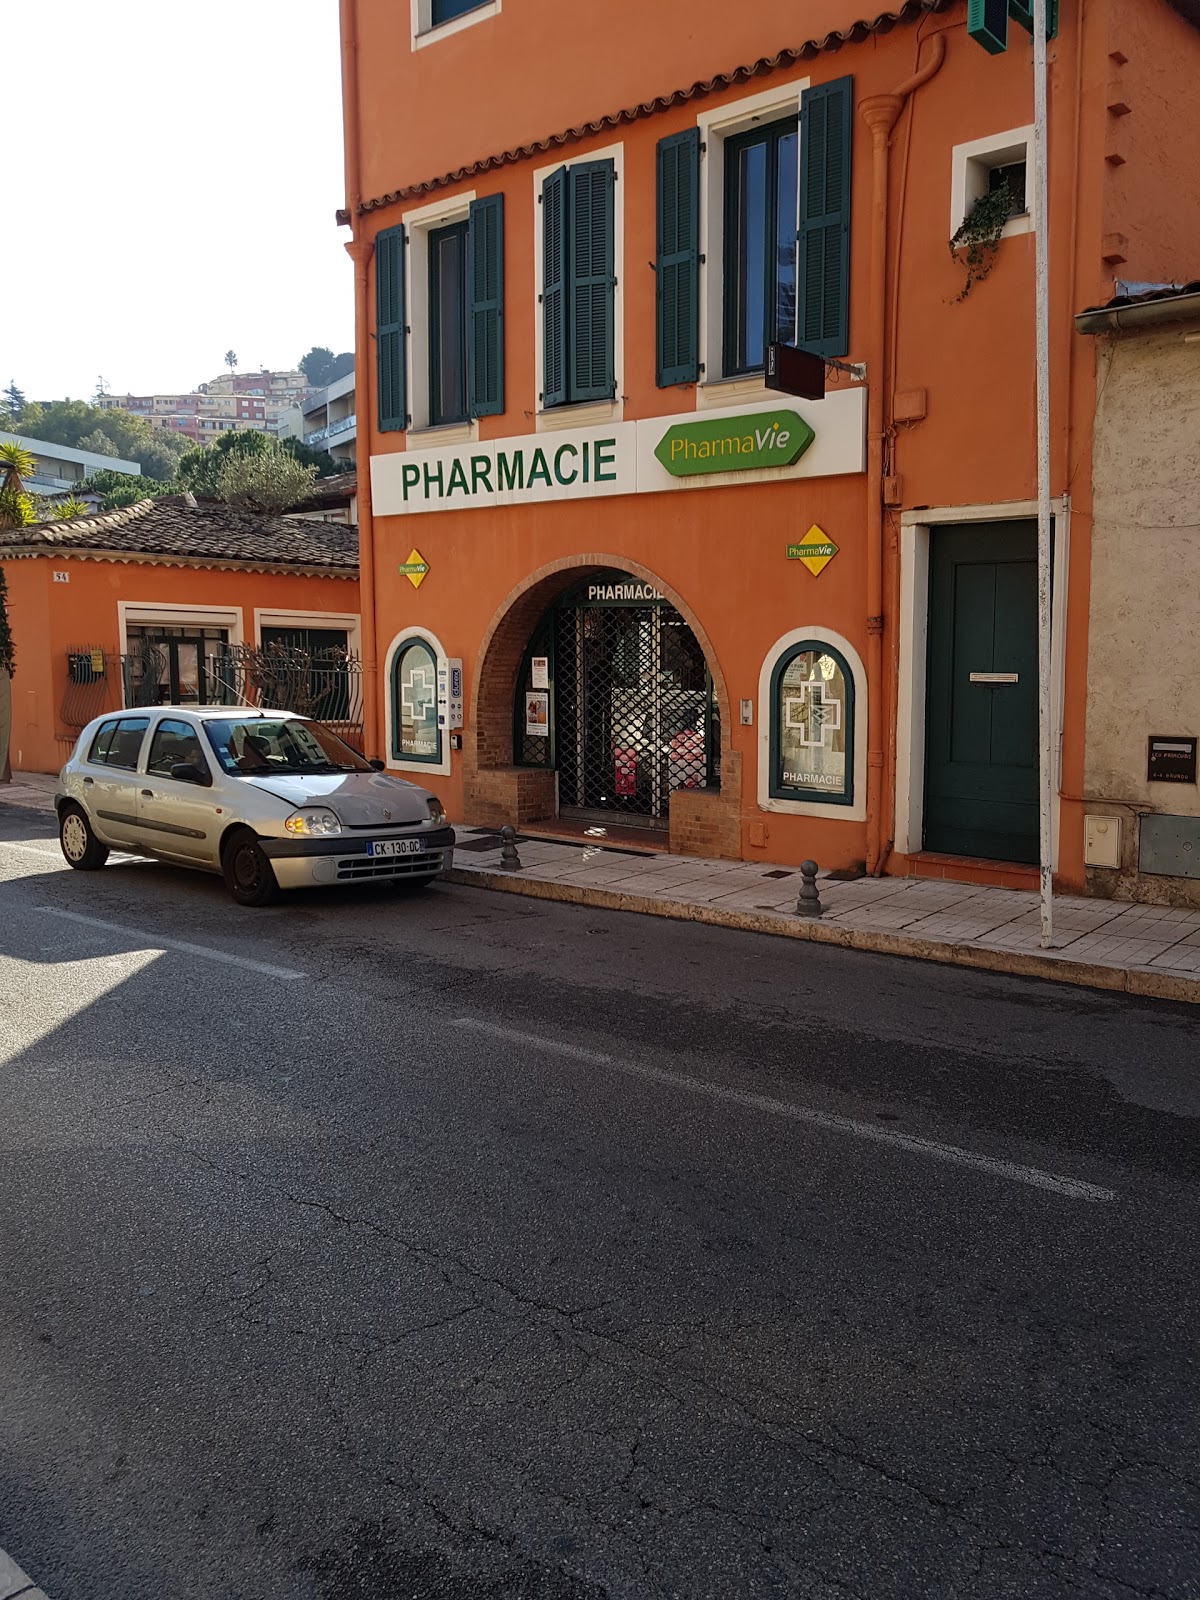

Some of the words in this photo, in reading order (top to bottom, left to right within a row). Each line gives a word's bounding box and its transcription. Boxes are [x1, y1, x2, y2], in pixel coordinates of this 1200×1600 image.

[671, 422, 791, 461] PharmaVie
[401, 438, 617, 501] PHARMACIE
[789, 545, 832, 556] PharmaVie
[402, 739, 437, 750] PHARMACIE
[783, 771, 842, 786] PHARMACIE
